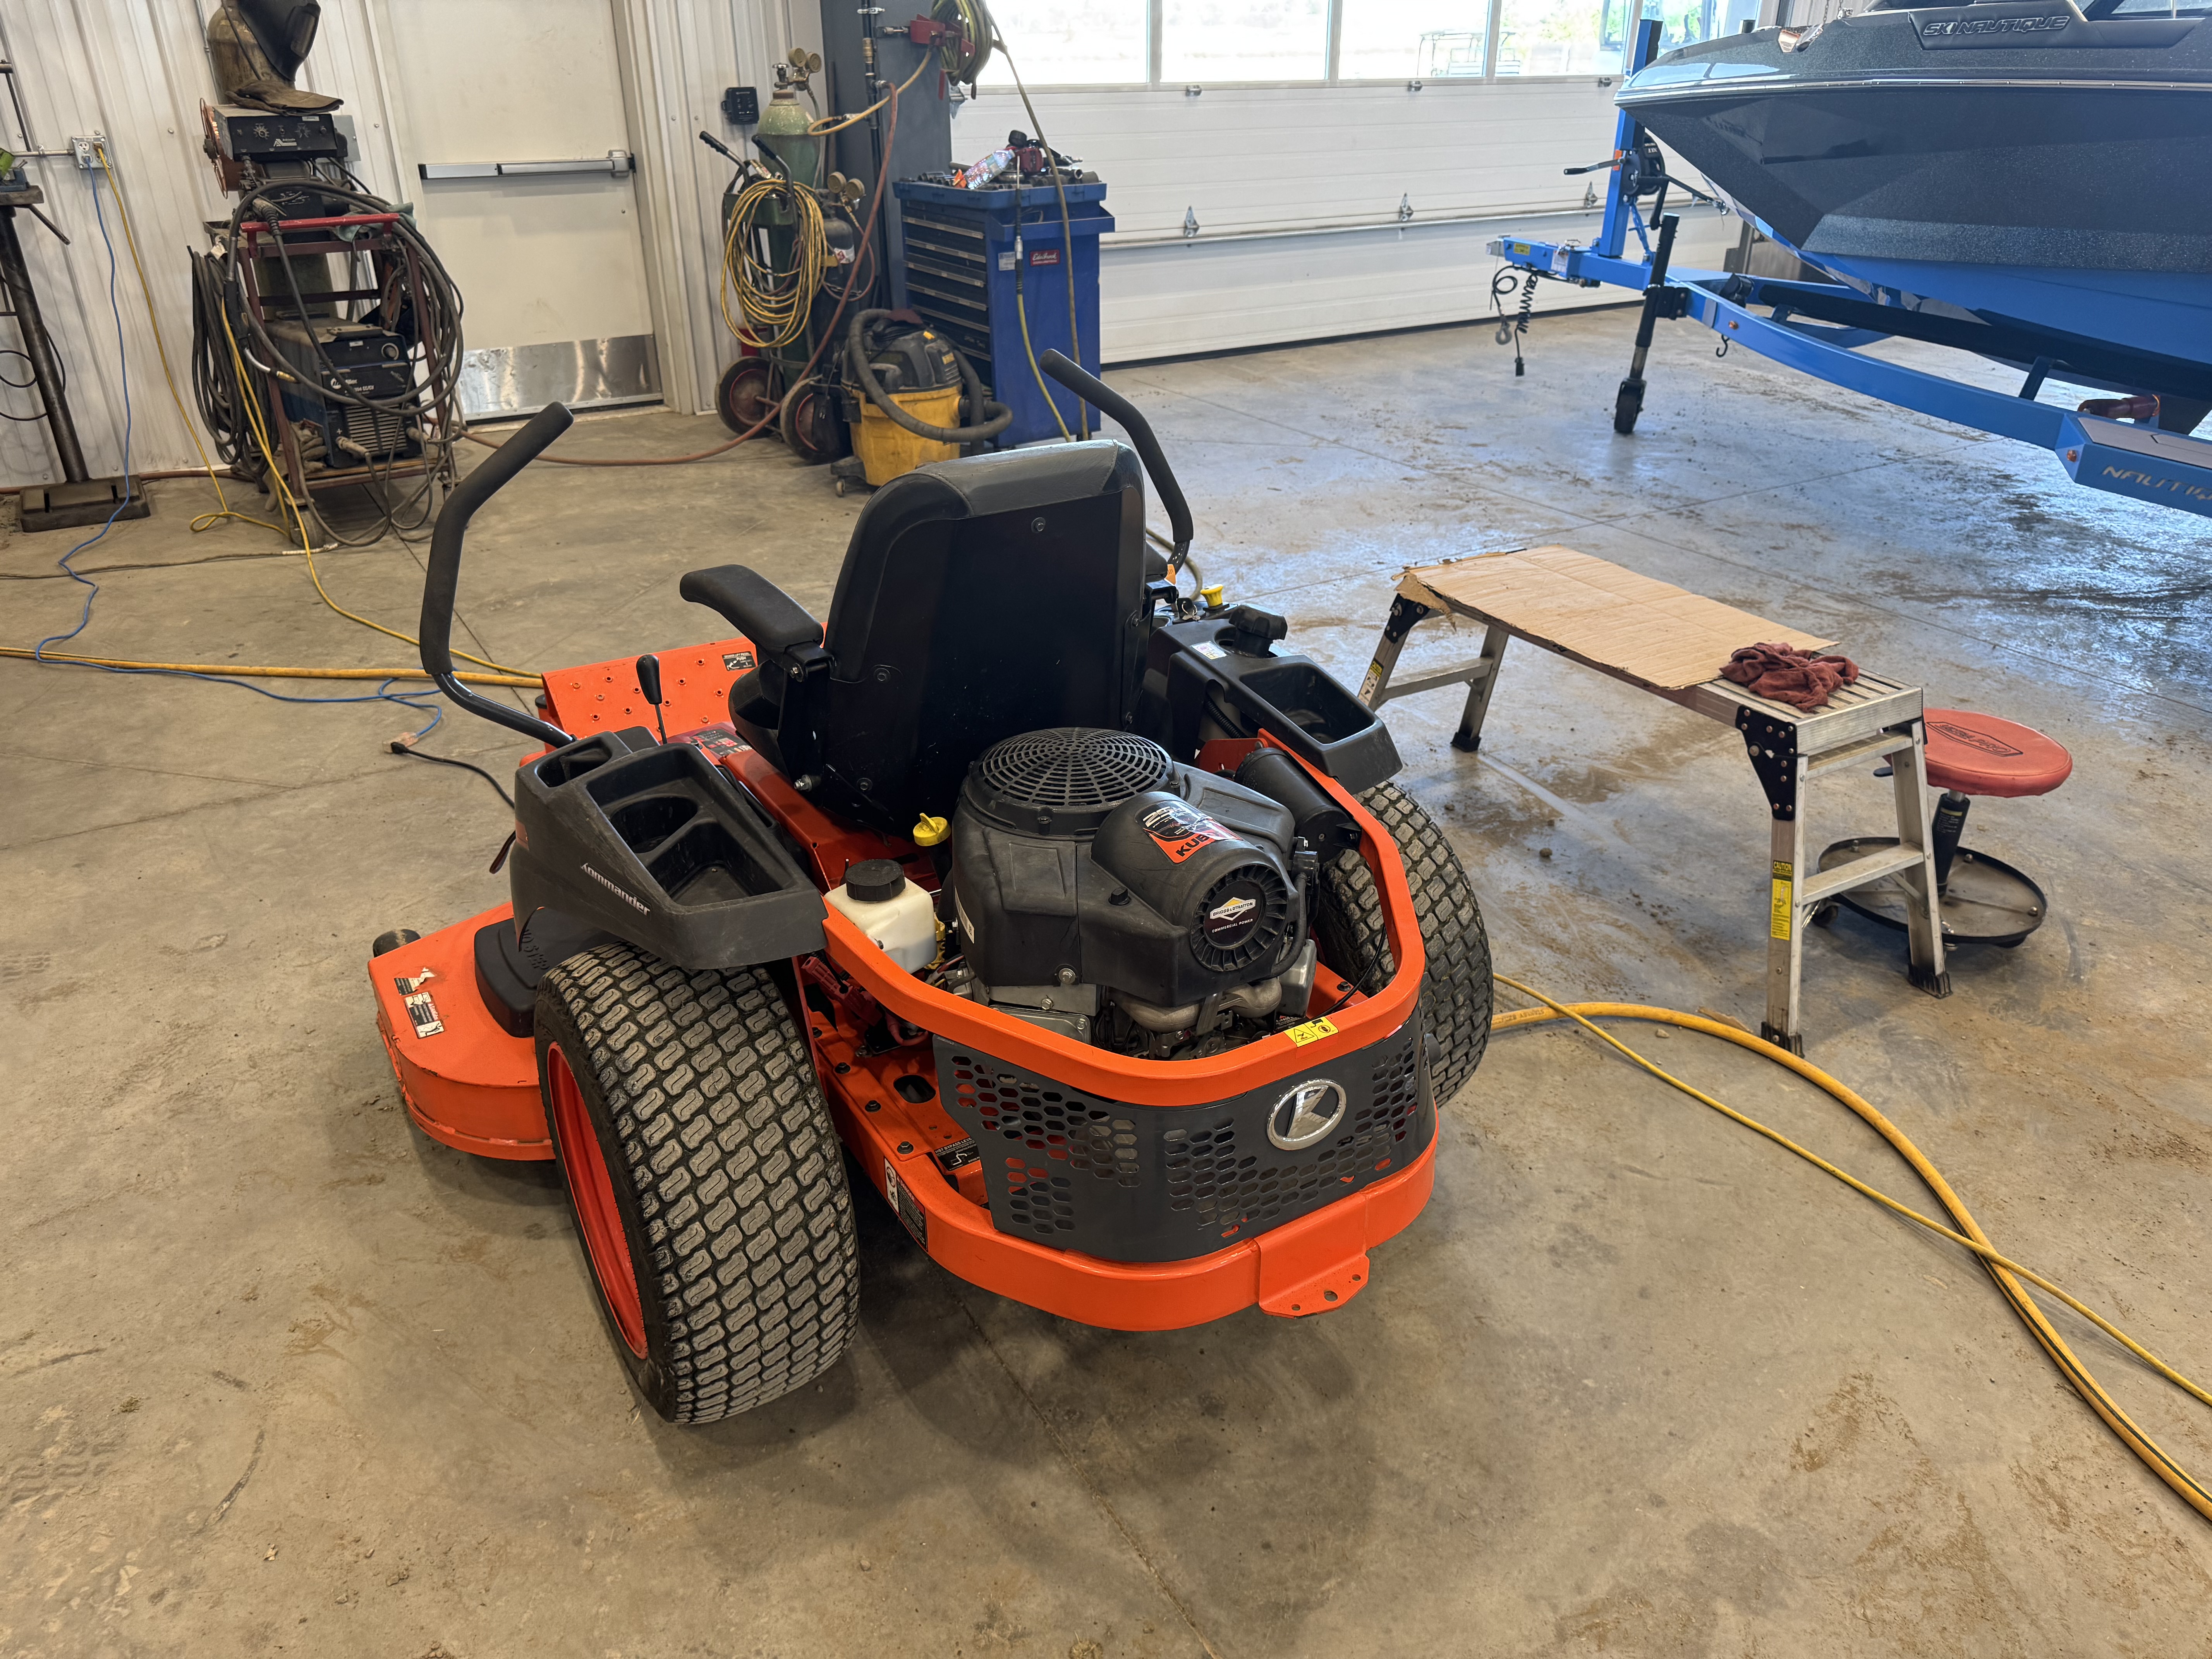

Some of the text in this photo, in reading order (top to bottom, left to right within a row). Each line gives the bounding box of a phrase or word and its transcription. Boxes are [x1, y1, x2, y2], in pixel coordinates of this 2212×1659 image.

[1923, 16, 2070, 35] SKI NAUTIQUE
[1032, 252, 1057, 261] Edelbrock
[1774, 861, 1792, 871] CAUTION
[1212, 923, 1238, 933] COMMERCIAL
[944, 1141, 961, 1150] BYPASS
